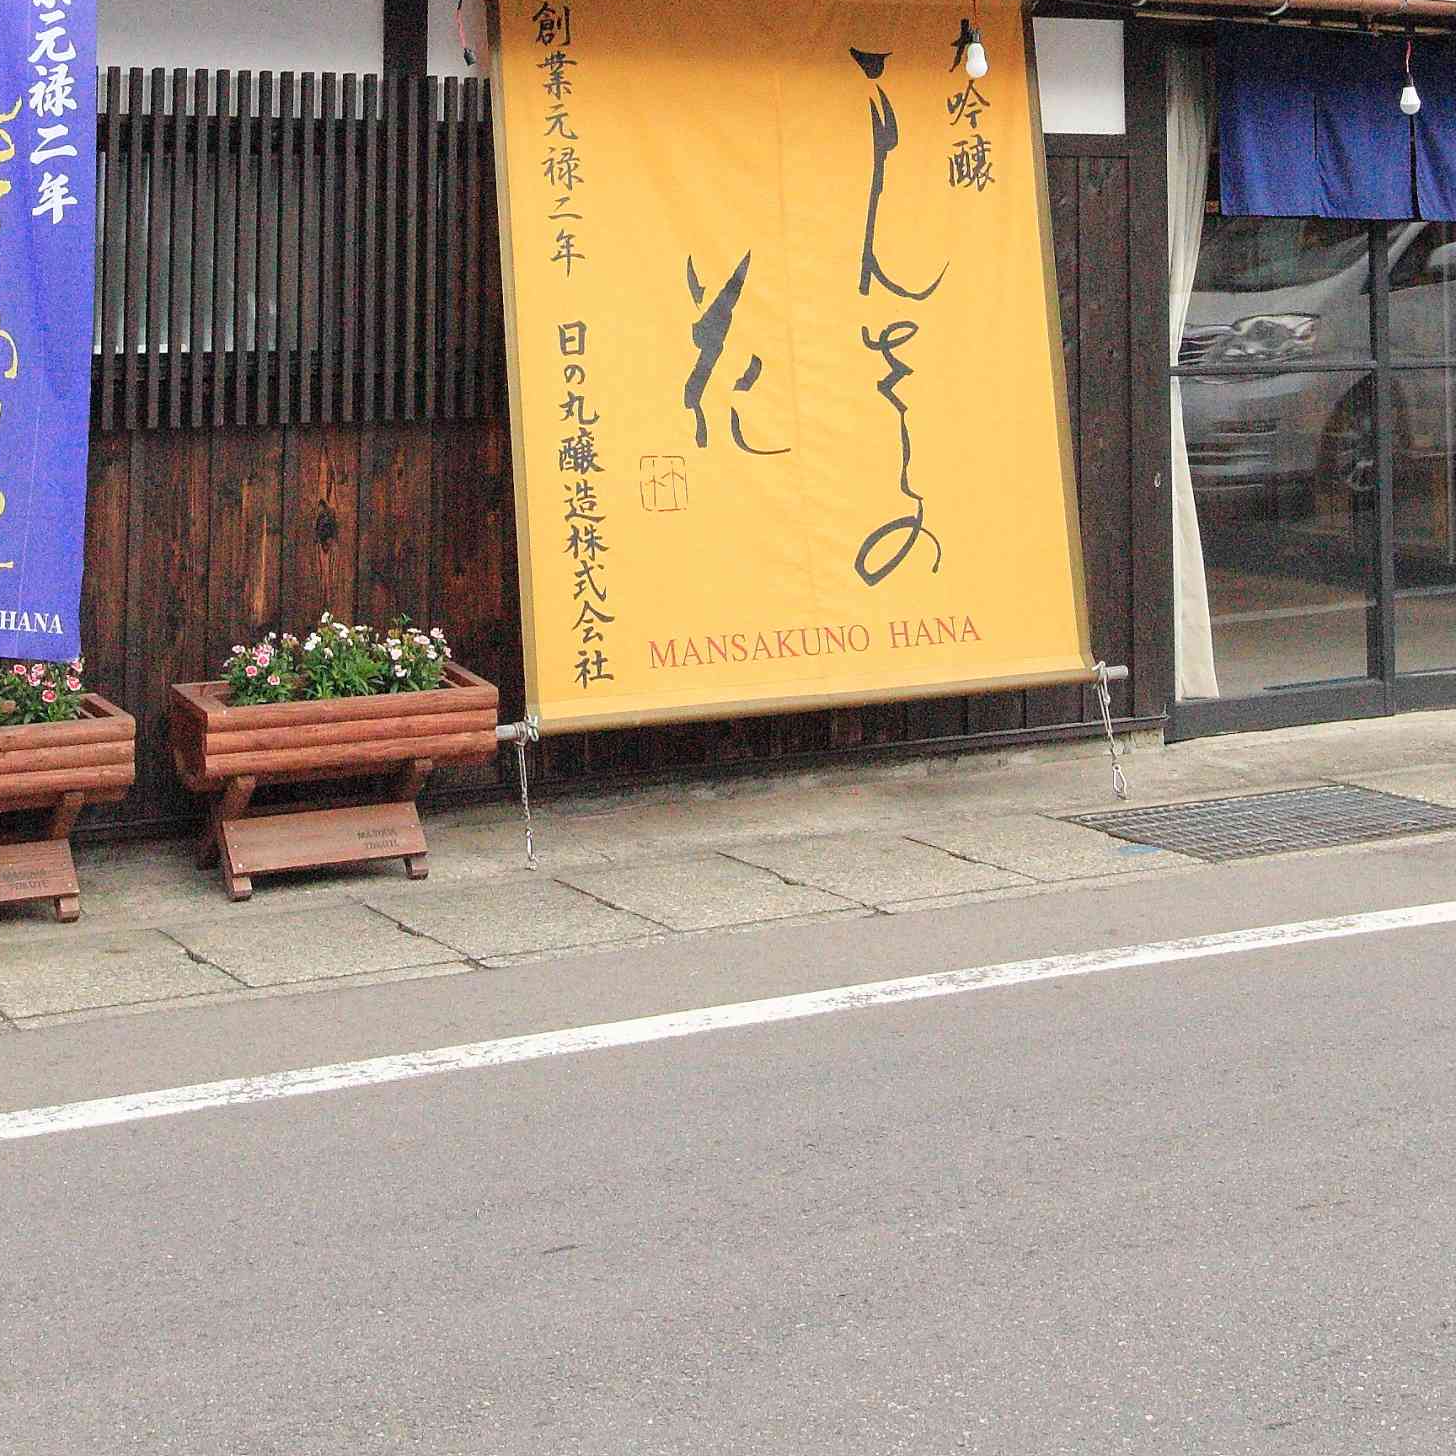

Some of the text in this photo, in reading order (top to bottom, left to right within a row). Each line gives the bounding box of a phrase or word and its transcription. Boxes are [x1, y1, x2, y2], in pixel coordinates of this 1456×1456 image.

[532, 1, 616, 690] 創業元禄二年 日の丸醸造株式会社
[0, 609, 64, 634] HANA
[647, 615, 983, 670] MANSAKUNO HANA
